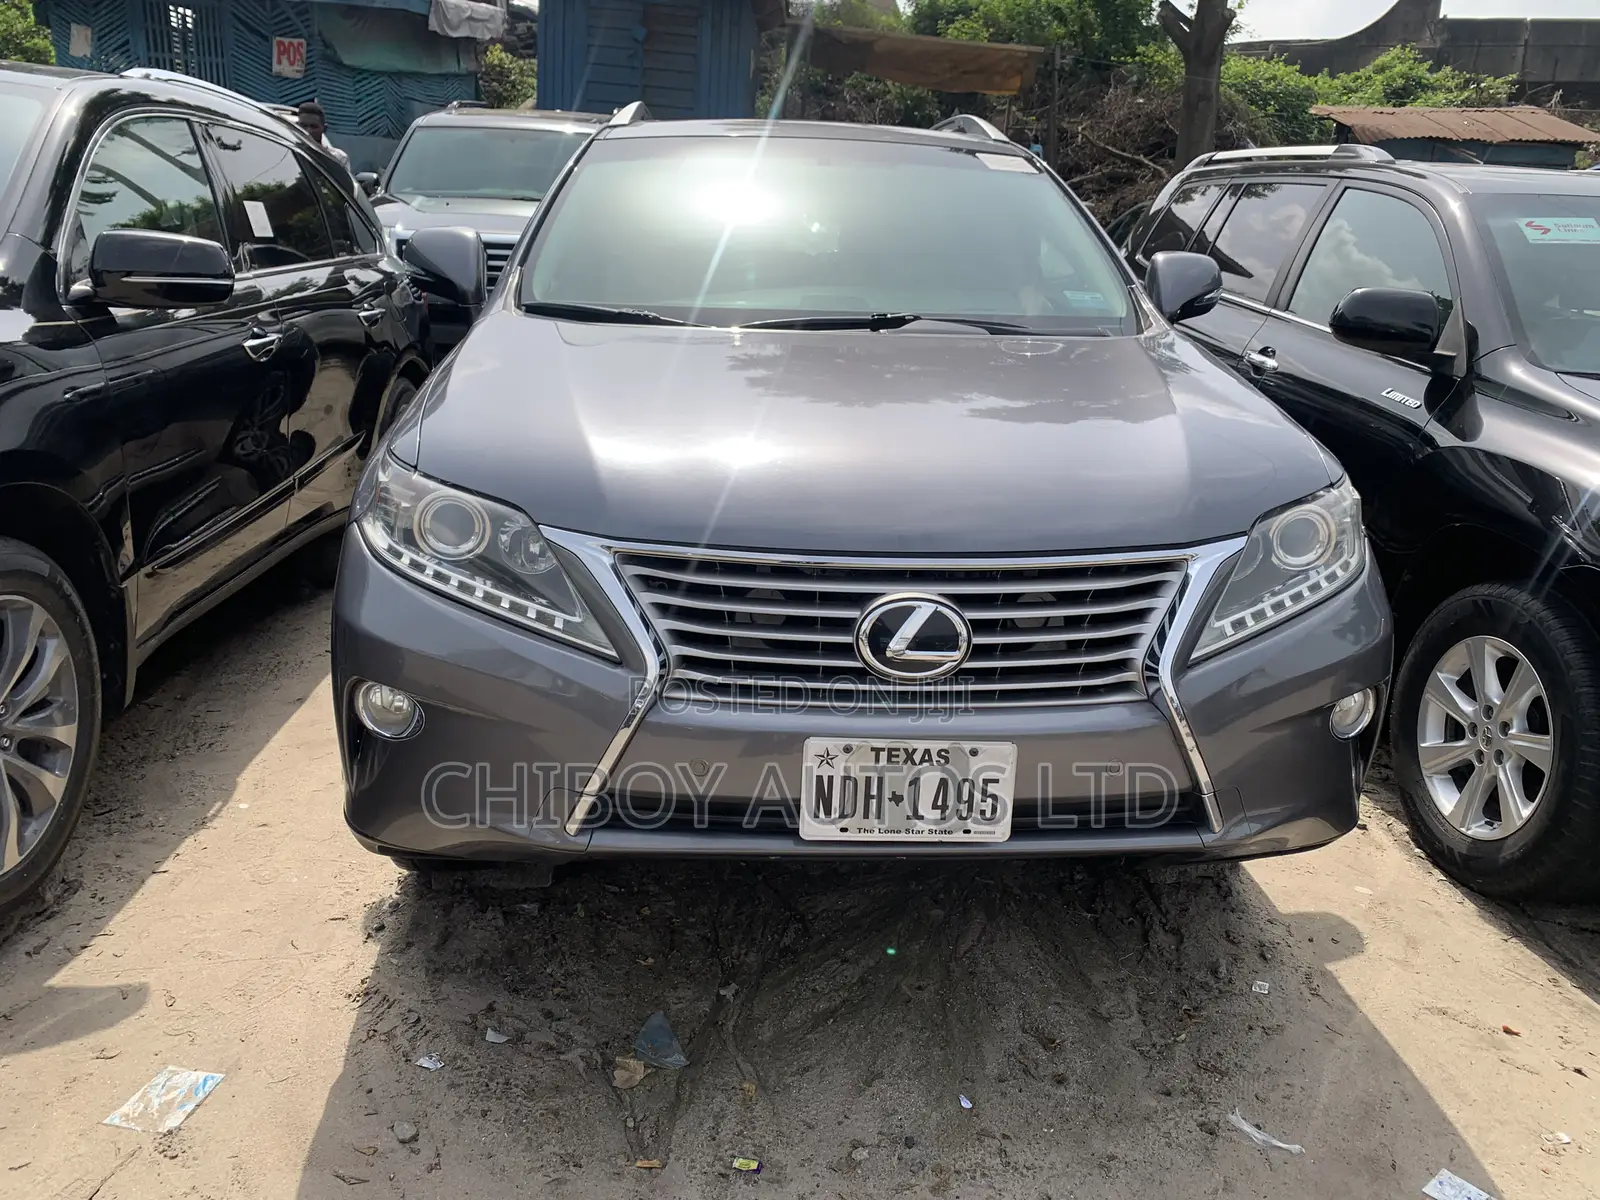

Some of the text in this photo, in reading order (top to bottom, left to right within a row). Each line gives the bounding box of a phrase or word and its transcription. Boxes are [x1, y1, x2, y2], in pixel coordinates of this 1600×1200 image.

[276, 40, 304, 66] POS
[870, 747, 950, 766] TEXAS
[857, 827, 954, 836] The Lone Star State
